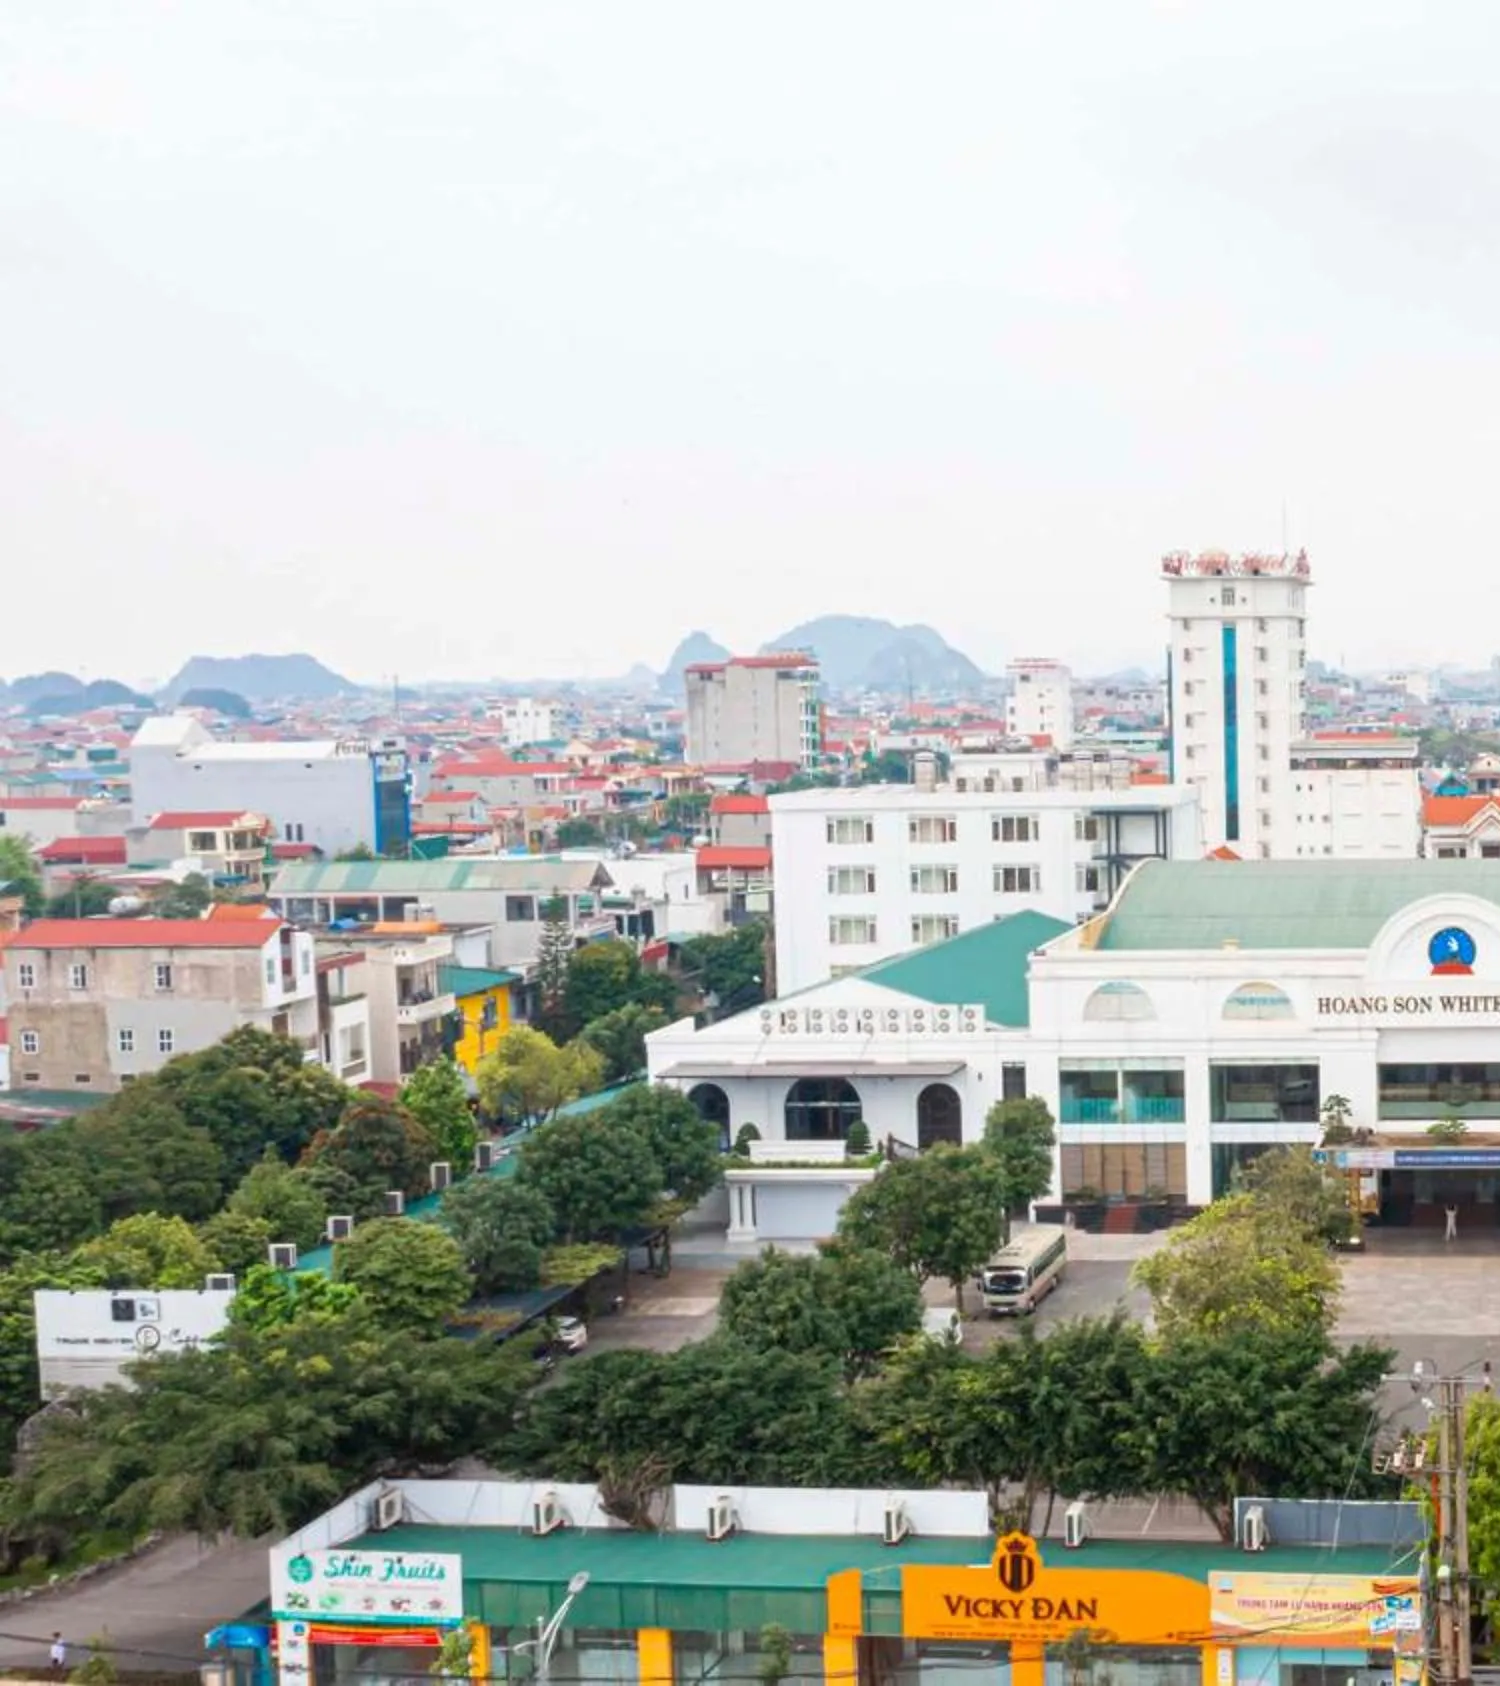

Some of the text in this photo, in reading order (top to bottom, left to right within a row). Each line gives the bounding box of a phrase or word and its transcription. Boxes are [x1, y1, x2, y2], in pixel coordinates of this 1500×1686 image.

[1318, 996, 1388, 1015] HOANG
[1393, 996, 1433, 1014] SON
[944, 1595, 1098, 1621] VICKY ĐAN
